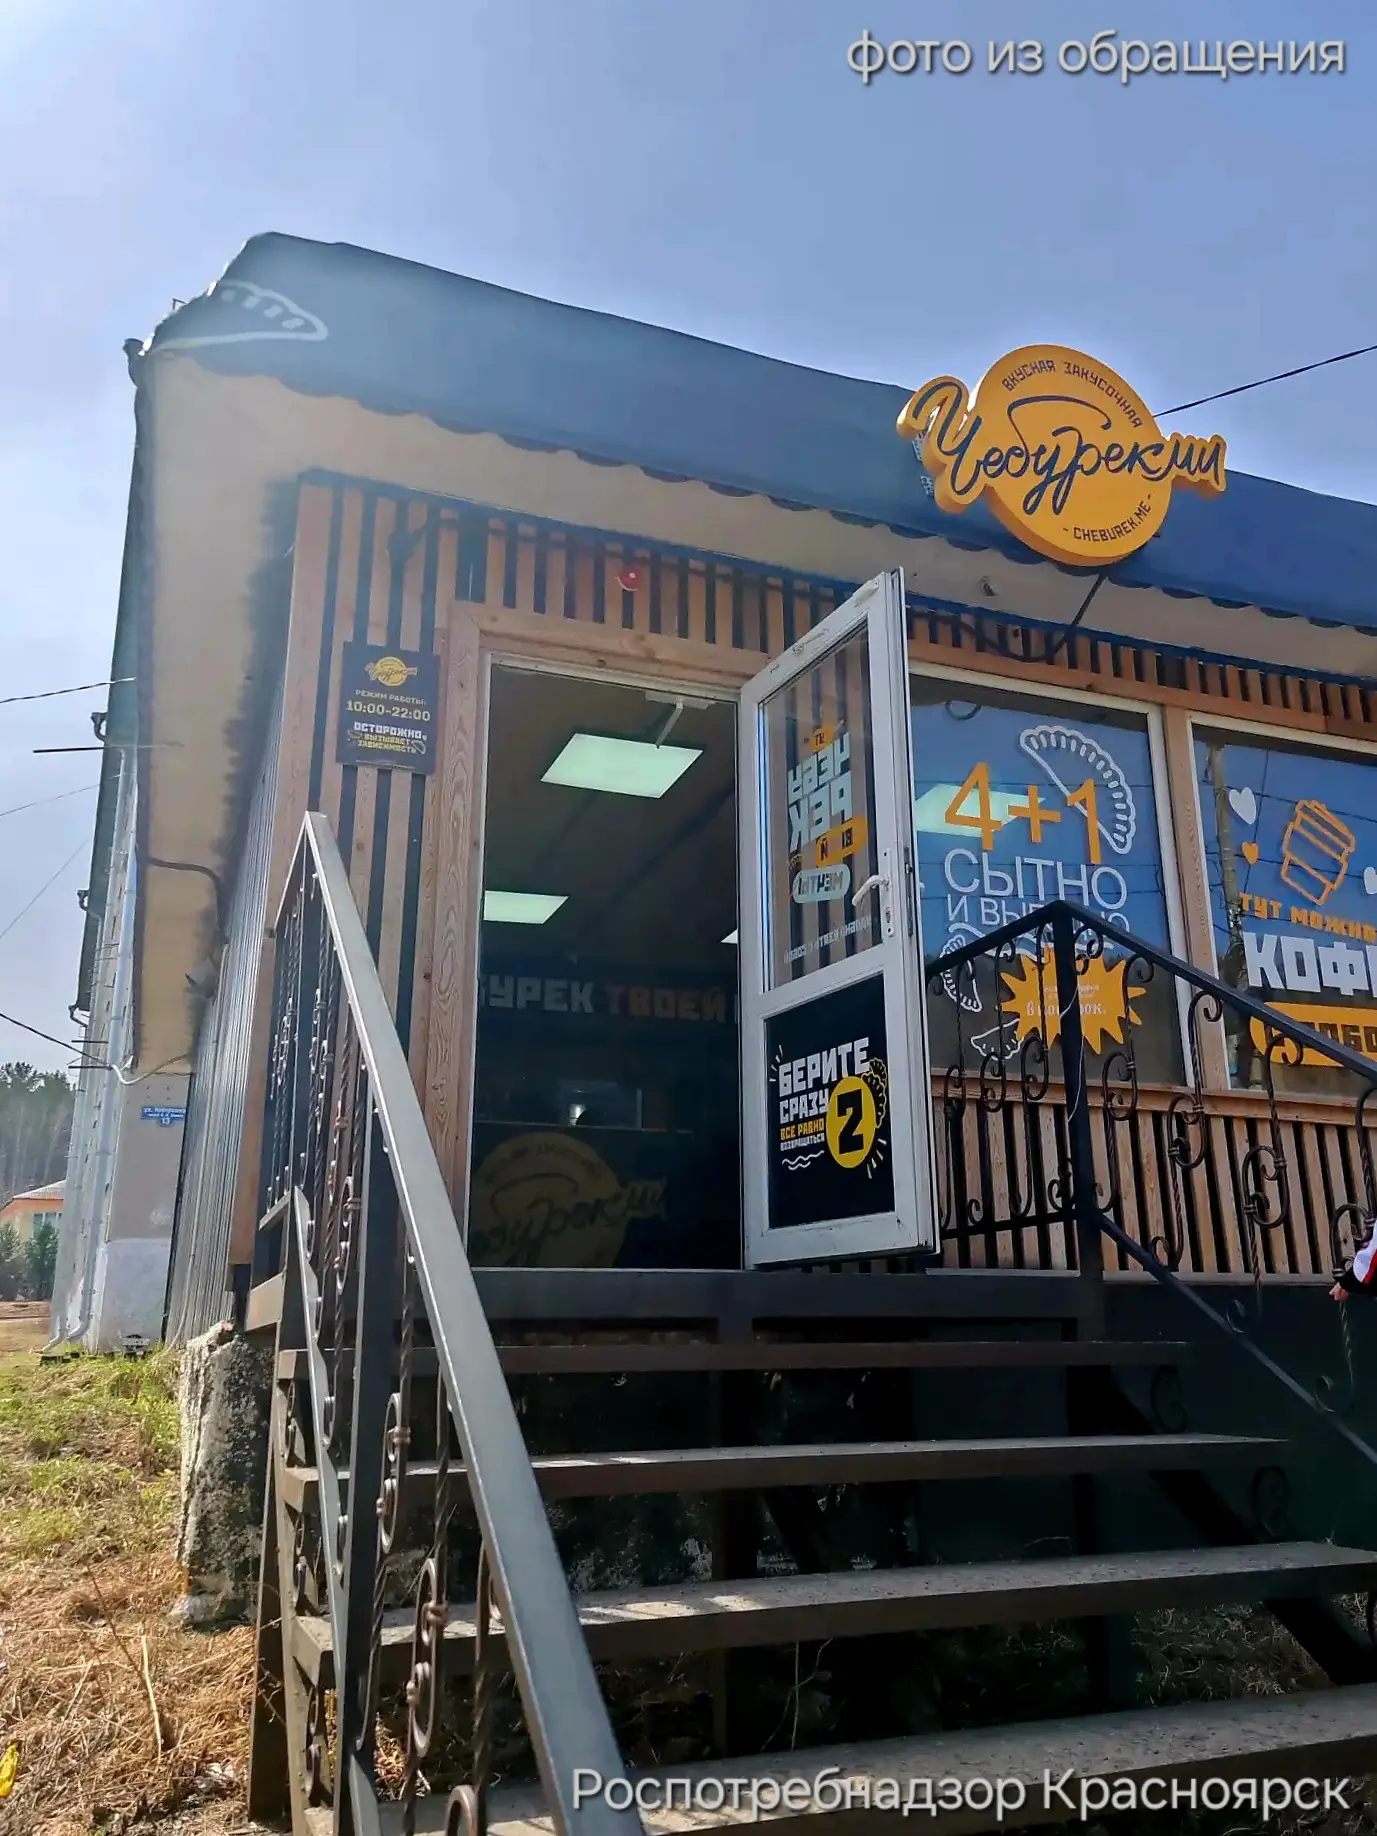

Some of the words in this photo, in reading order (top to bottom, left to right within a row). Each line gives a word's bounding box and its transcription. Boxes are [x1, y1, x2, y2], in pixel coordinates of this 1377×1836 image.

[1002, 360, 1056, 391] ВКУСНАЯ
[1064, 361, 1142, 428] ЗАКУСОЧНАЯ
[912, 381, 1221, 516] Чебурекми
[346, 700, 431, 721] 10:00-22:00
[355, 689, 387, 700] РЕЖИМ
[945, 762, 1101, 864] 4+1
[944, 848, 1127, 910] СЫТНО
[946, 894, 968, 923] И
[1239, 891, 1282, 919] ТУТ
[1290, 905, 1376, 943] МОЖНО
[602, 984, 727, 1023] ТВОЕЙ
[779, 1037, 870, 1097] БЕРИТЕ
[779, 1088, 829, 1124] СРАЗУ
[836, 1088, 864, 1155] 2
[780, 1123, 796, 1140] ВСЕ
[797, 1118, 825, 1137] РАВНО
